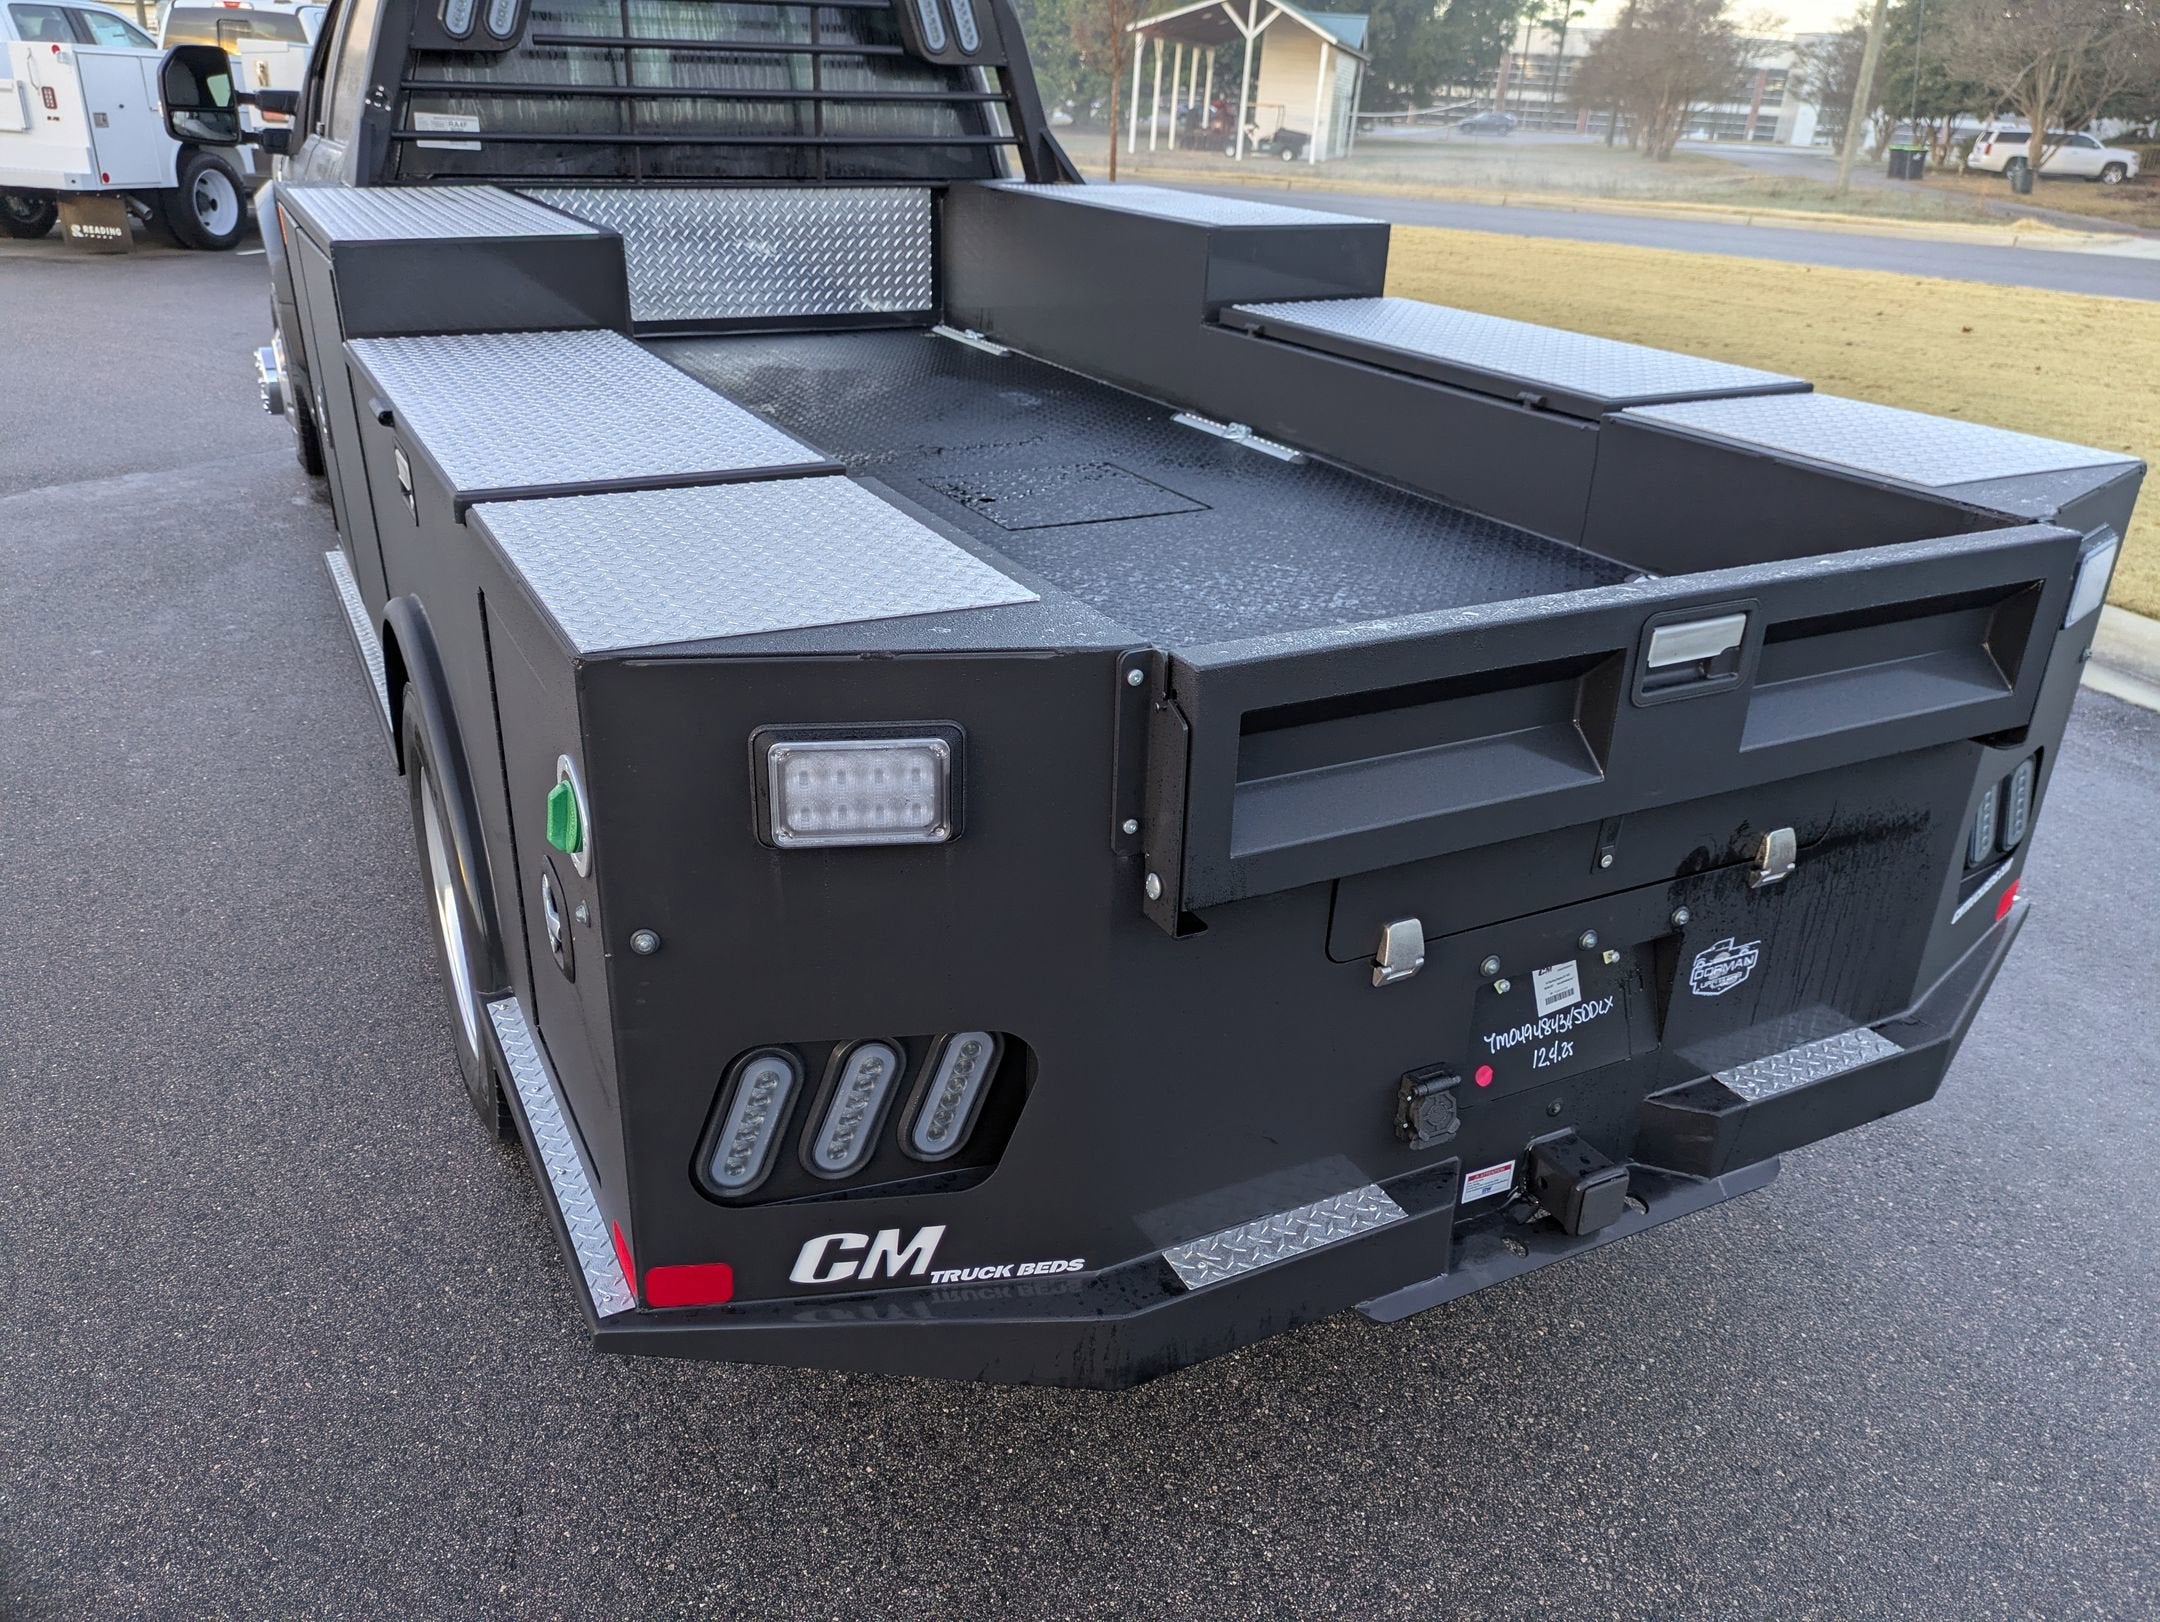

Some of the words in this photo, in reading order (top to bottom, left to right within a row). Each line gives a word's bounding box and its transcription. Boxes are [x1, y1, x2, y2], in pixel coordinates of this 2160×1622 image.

[82, 225, 122, 237] READING
[1694, 955, 1755, 980] DORMAN
[789, 1225, 947, 1283] CM
[930, 1263, 1014, 1284] TRUCK
[1016, 1258, 1086, 1277] BEDS
